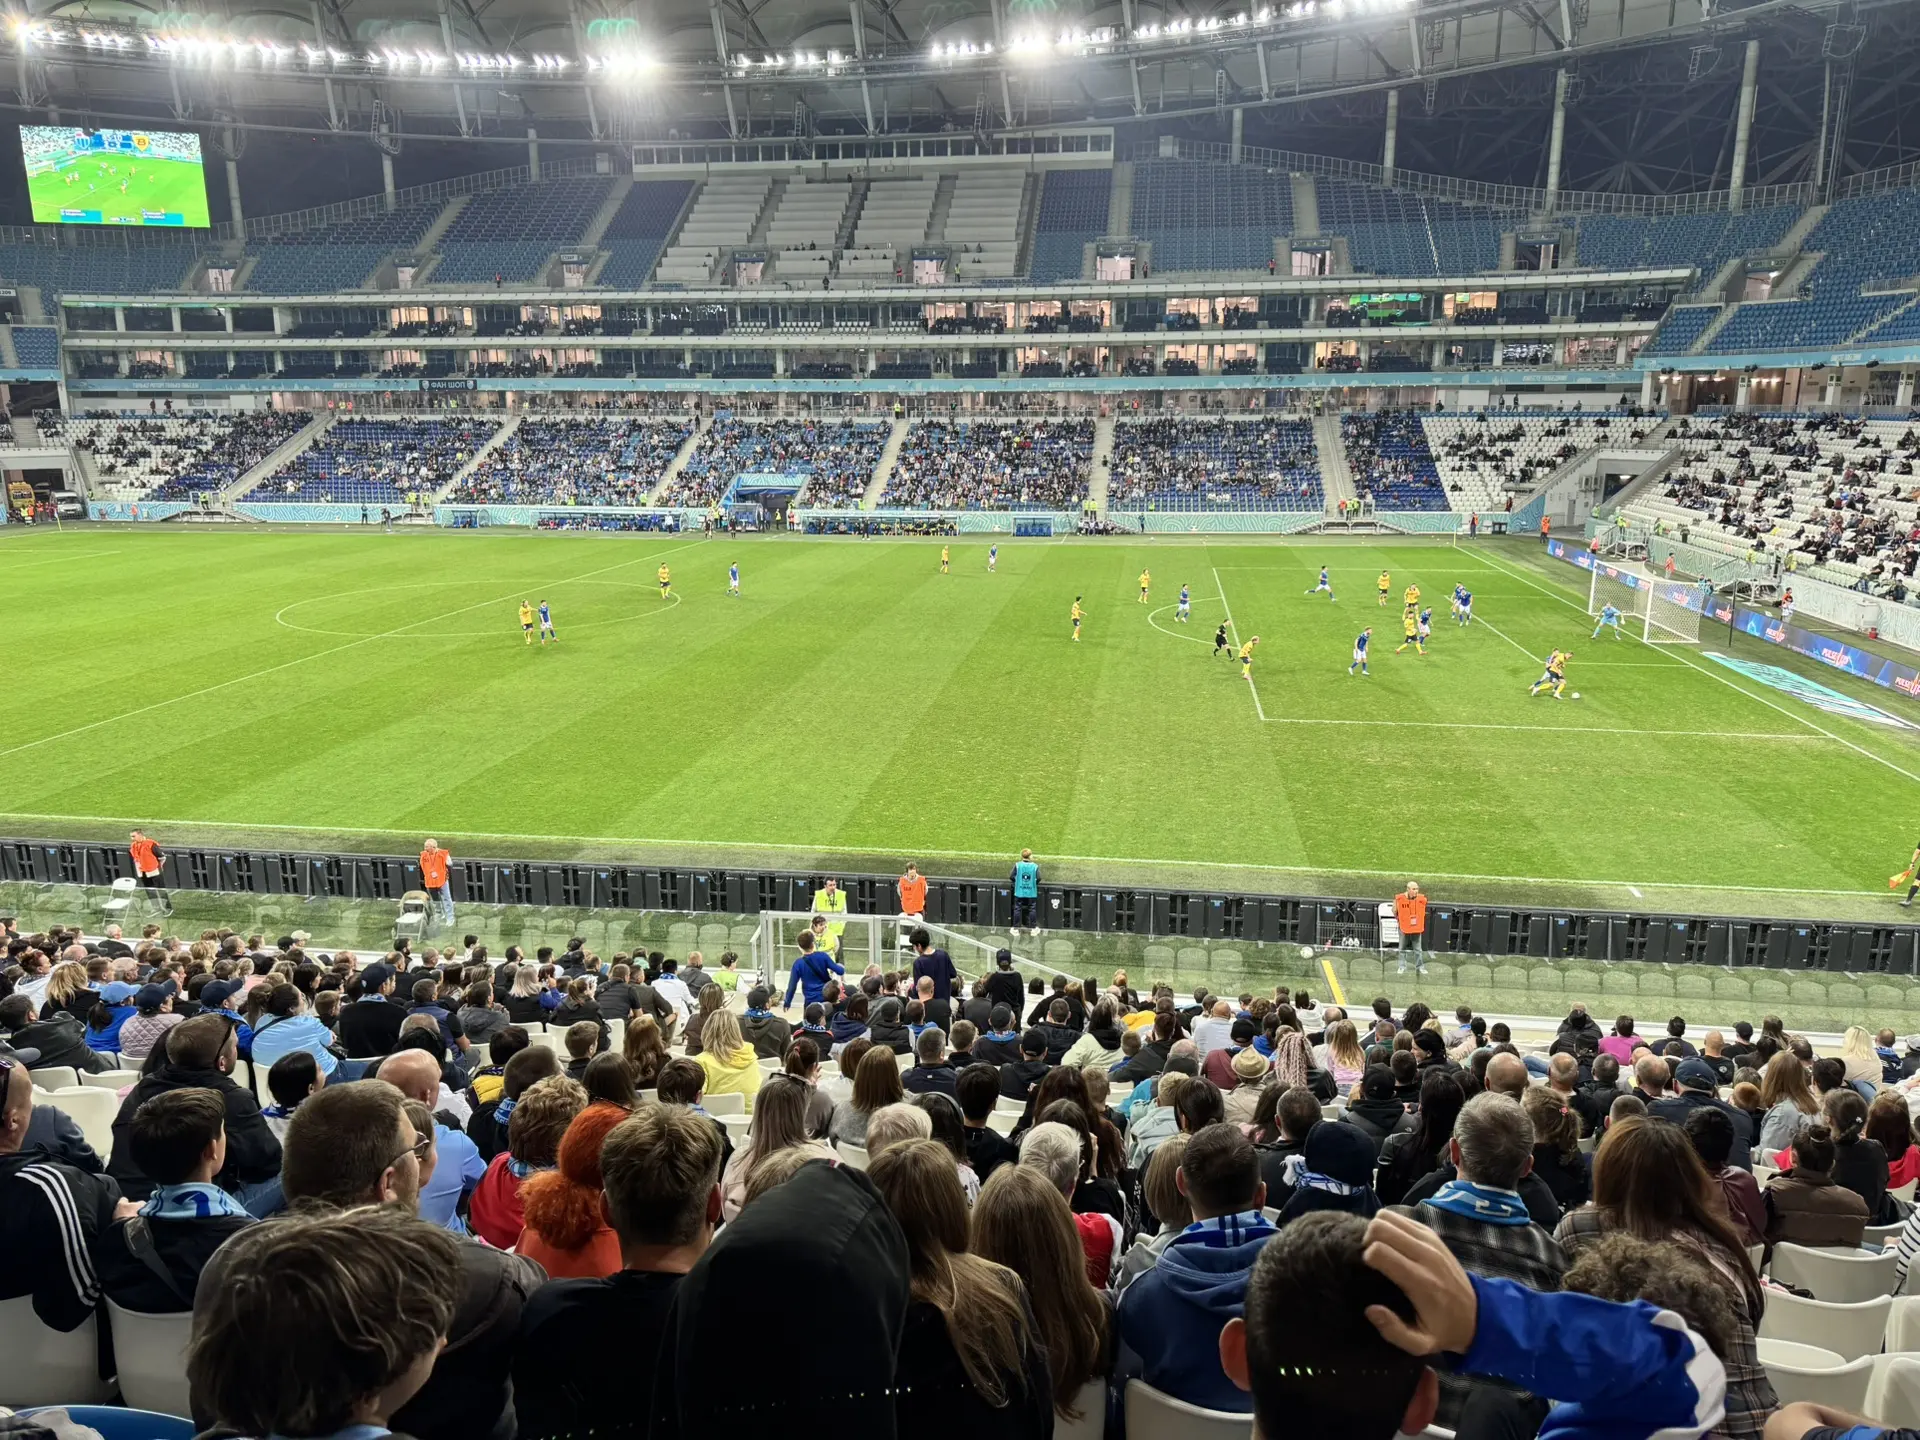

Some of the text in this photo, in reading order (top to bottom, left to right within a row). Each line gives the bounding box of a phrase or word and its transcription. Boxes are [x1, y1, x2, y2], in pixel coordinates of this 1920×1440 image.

[430, 381, 466, 389] ФАН ШОП
[1821, 647, 1838, 660] PULSE
[1895, 676, 1912, 688] PULSE
